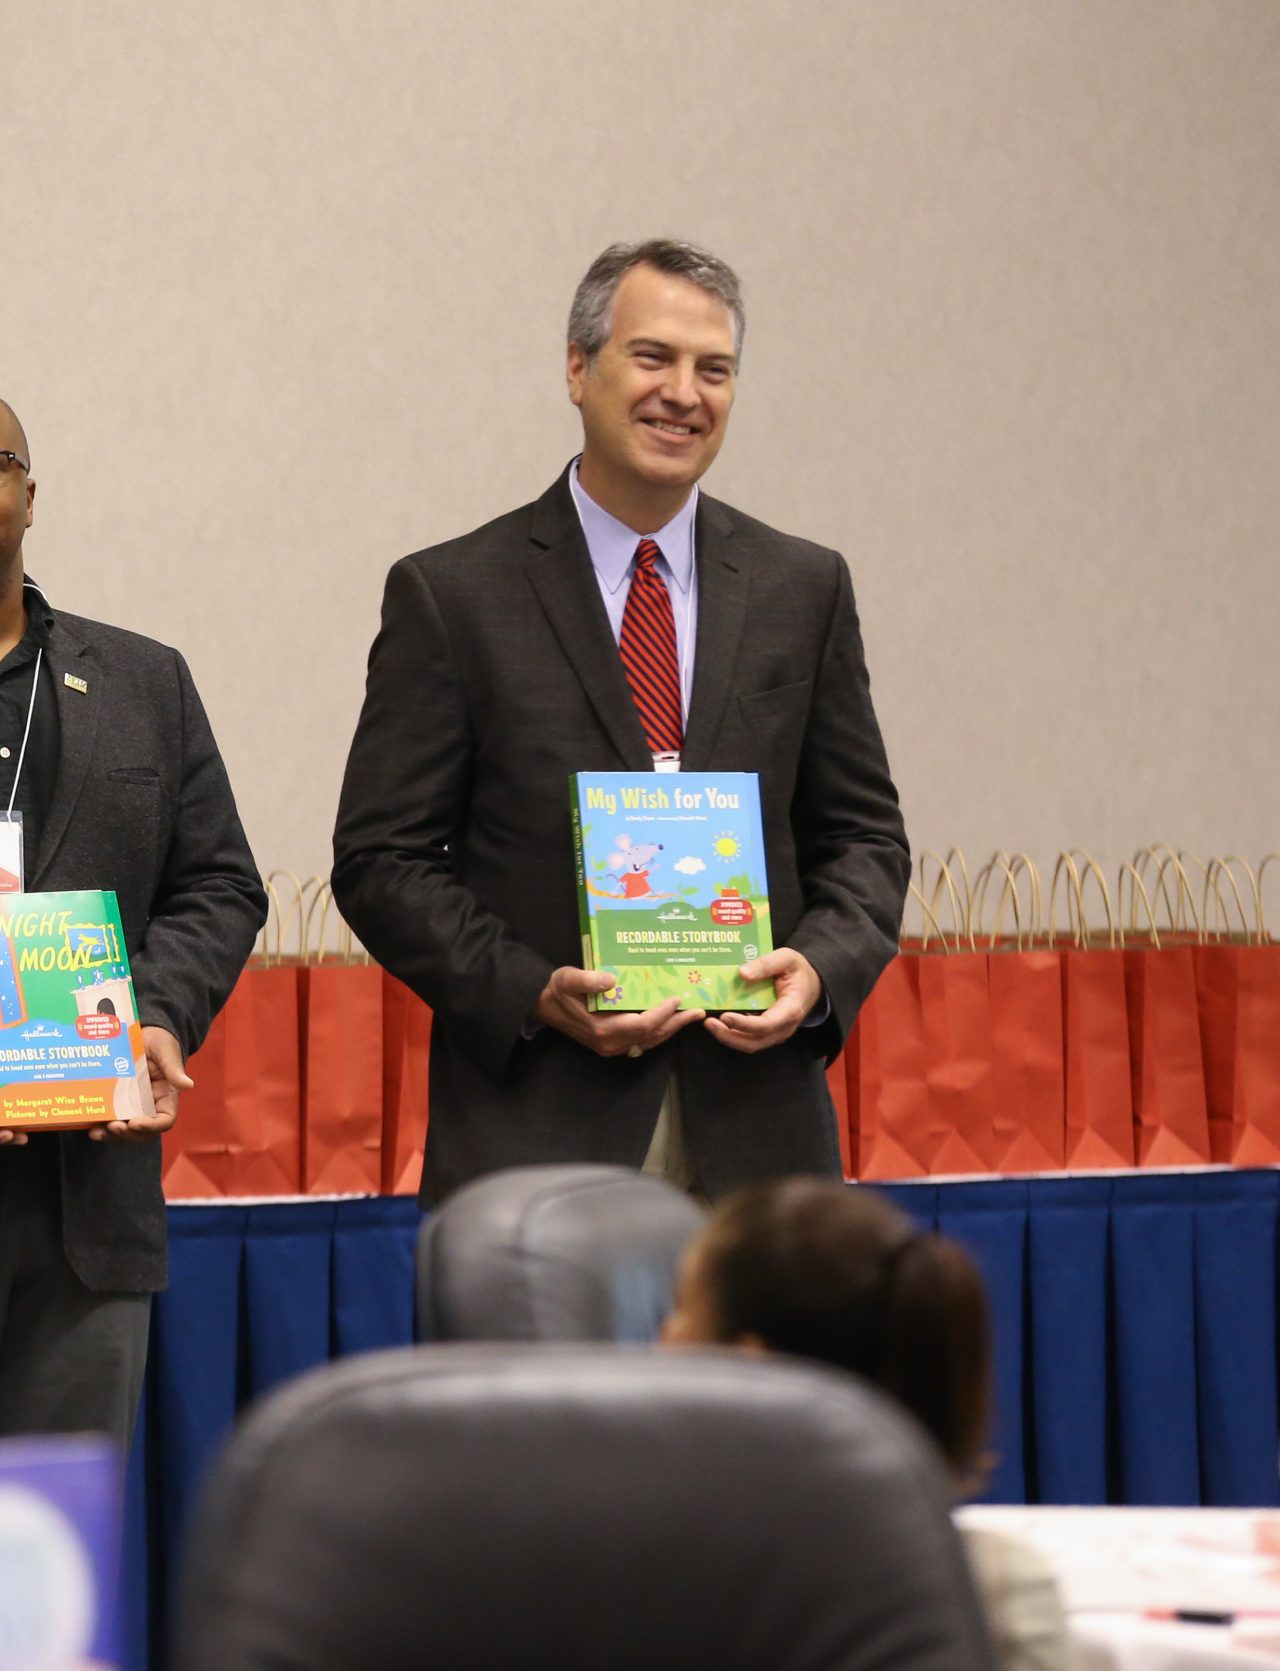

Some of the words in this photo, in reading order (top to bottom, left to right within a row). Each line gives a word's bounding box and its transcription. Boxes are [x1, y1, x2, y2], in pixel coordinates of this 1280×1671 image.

[586, 787, 617, 815] My
[620, 787, 669, 809] Wish
[674, 787, 702, 809] for
[704, 787, 739, 809] You
[656, 912, 698, 924] Hallmark
[616, 931, 680, 944] RECORDABLE
[682, 931, 741, 944] STORYBOOK
[20, 945, 93, 972] MOON
[21, 1030, 63, 1042] Hallmark
[49, 1044, 110, 1059] STORYBOOK
[3, 1099, 13, 1109] by
[16, 1097, 52, 1108] Margaret
[55, 1096, 76, 1104] Wise
[79, 1094, 104, 1103] Brown
[5, 1110, 36, 1119] Pictures
[39, 1109, 48, 1118] by
[51, 1107, 83, 1116] Clement
[86, 1105, 106, 1114] Hurd
